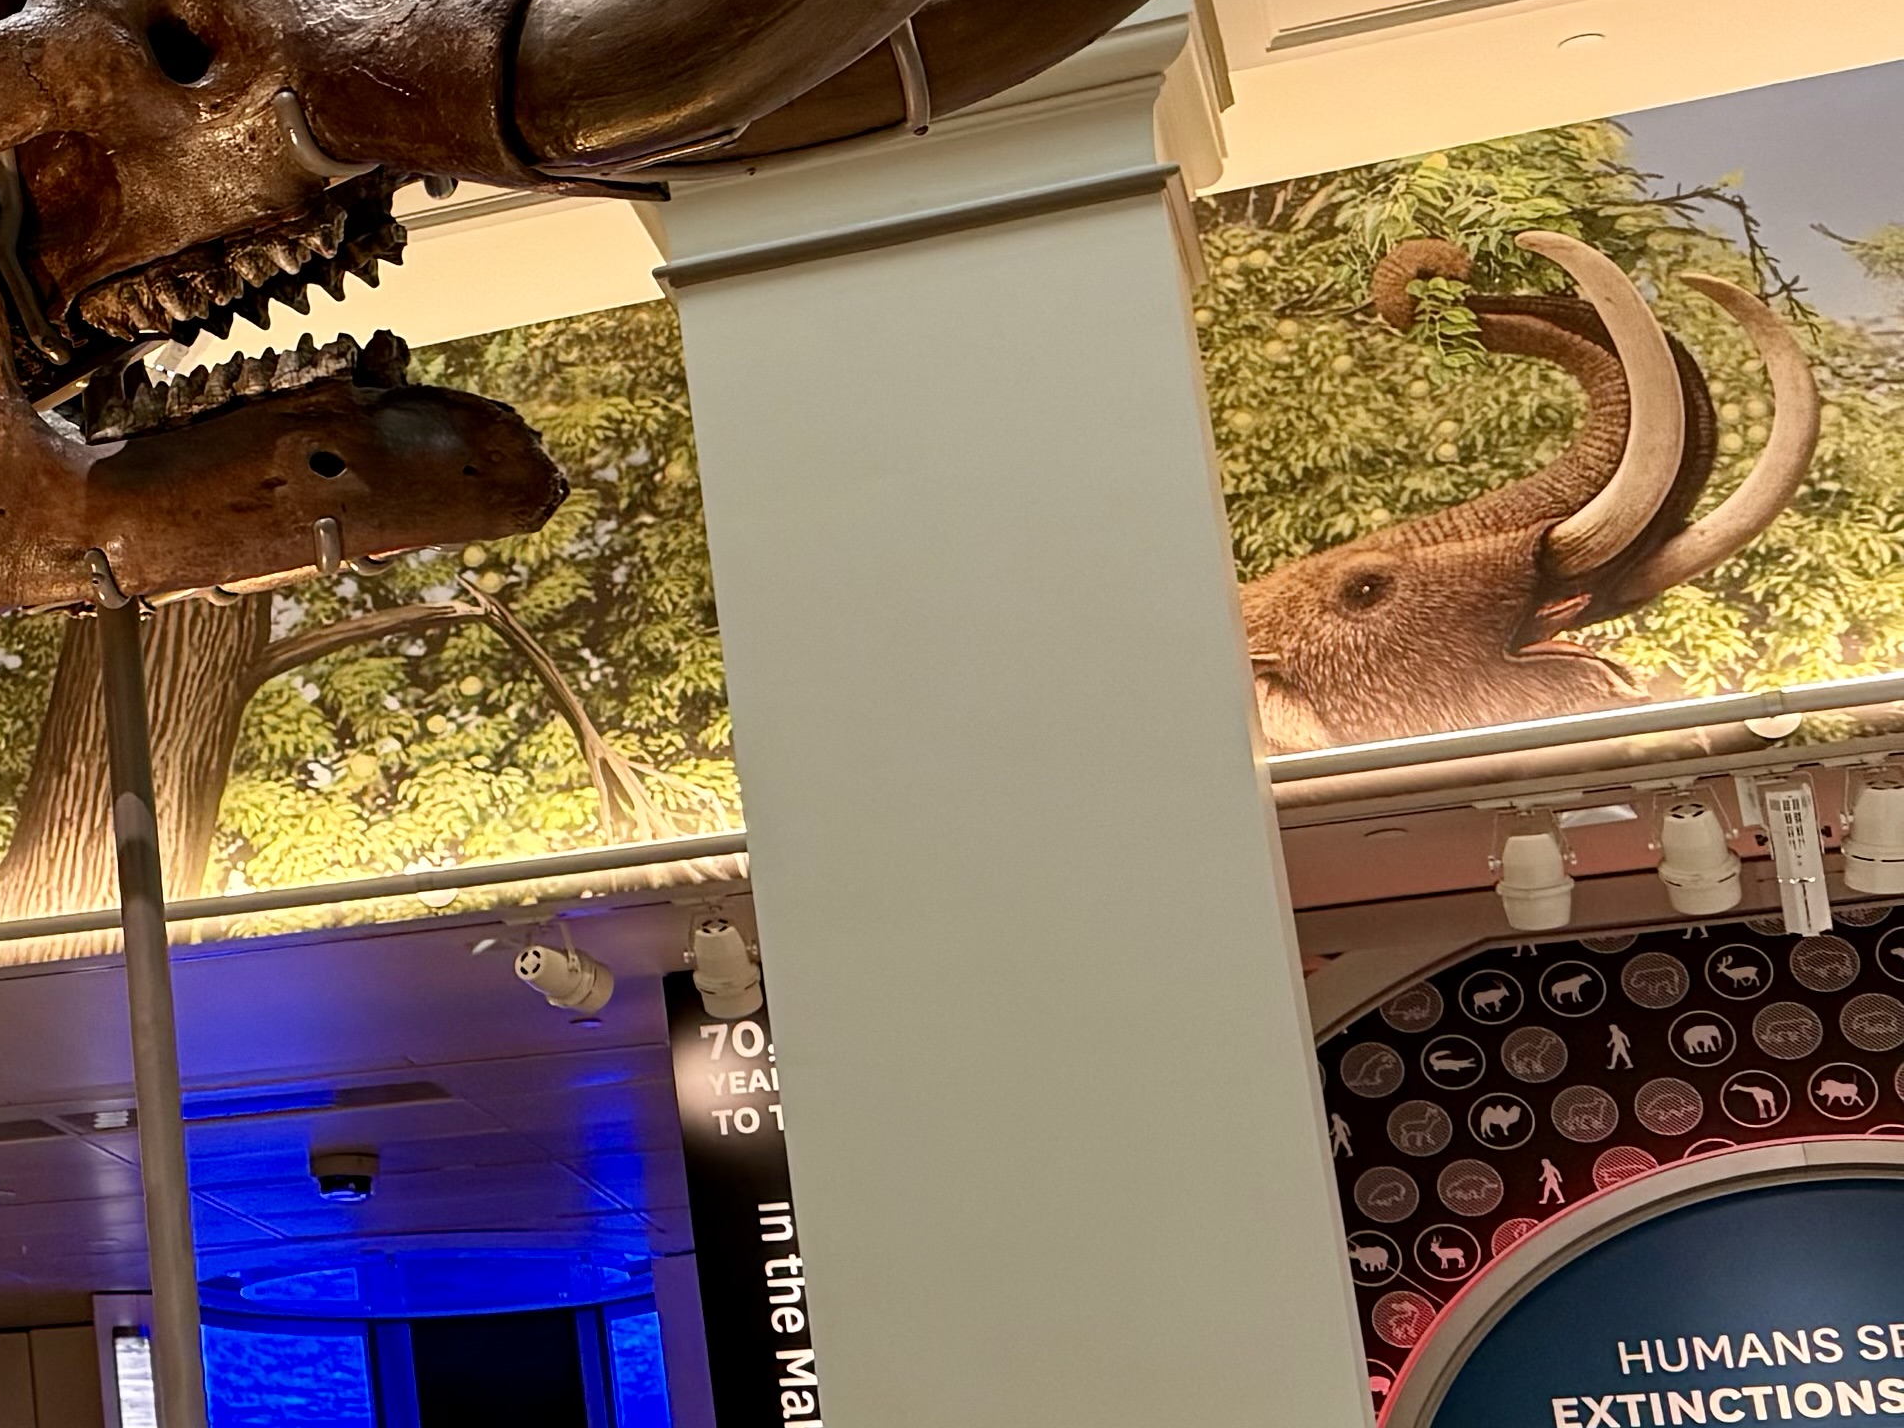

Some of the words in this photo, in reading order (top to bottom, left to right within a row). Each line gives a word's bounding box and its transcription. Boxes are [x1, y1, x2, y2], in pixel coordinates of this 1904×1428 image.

[711, 1107, 760, 1136] TO
[758, 1202, 794, 1242] In
[765, 1254, 806, 1333] the
[1617, 1327, 1844, 1375] HUMANS
